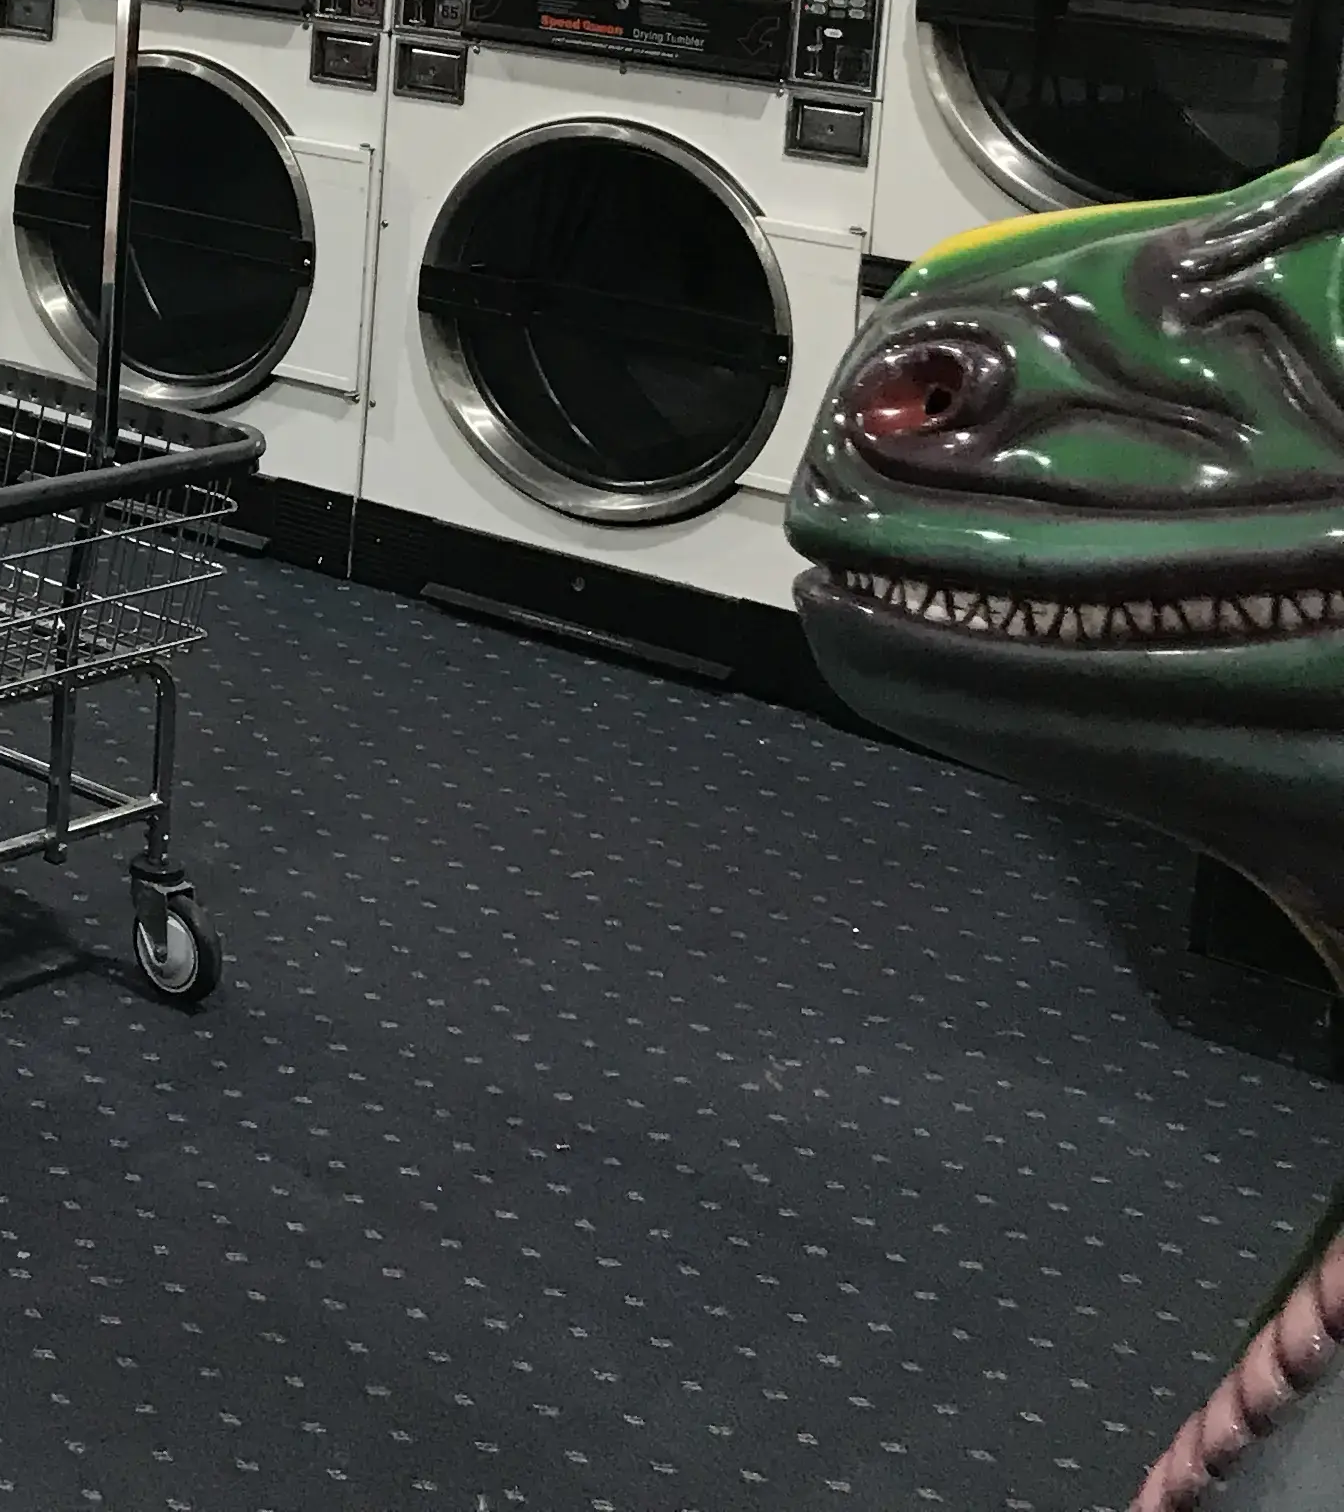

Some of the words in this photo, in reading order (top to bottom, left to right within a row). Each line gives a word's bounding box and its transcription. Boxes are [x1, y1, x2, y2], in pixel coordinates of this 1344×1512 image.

[441, 5, 459, 21] 65
[633, 28, 664, 42] Drying
[666, 32, 705, 47] Tumbler
